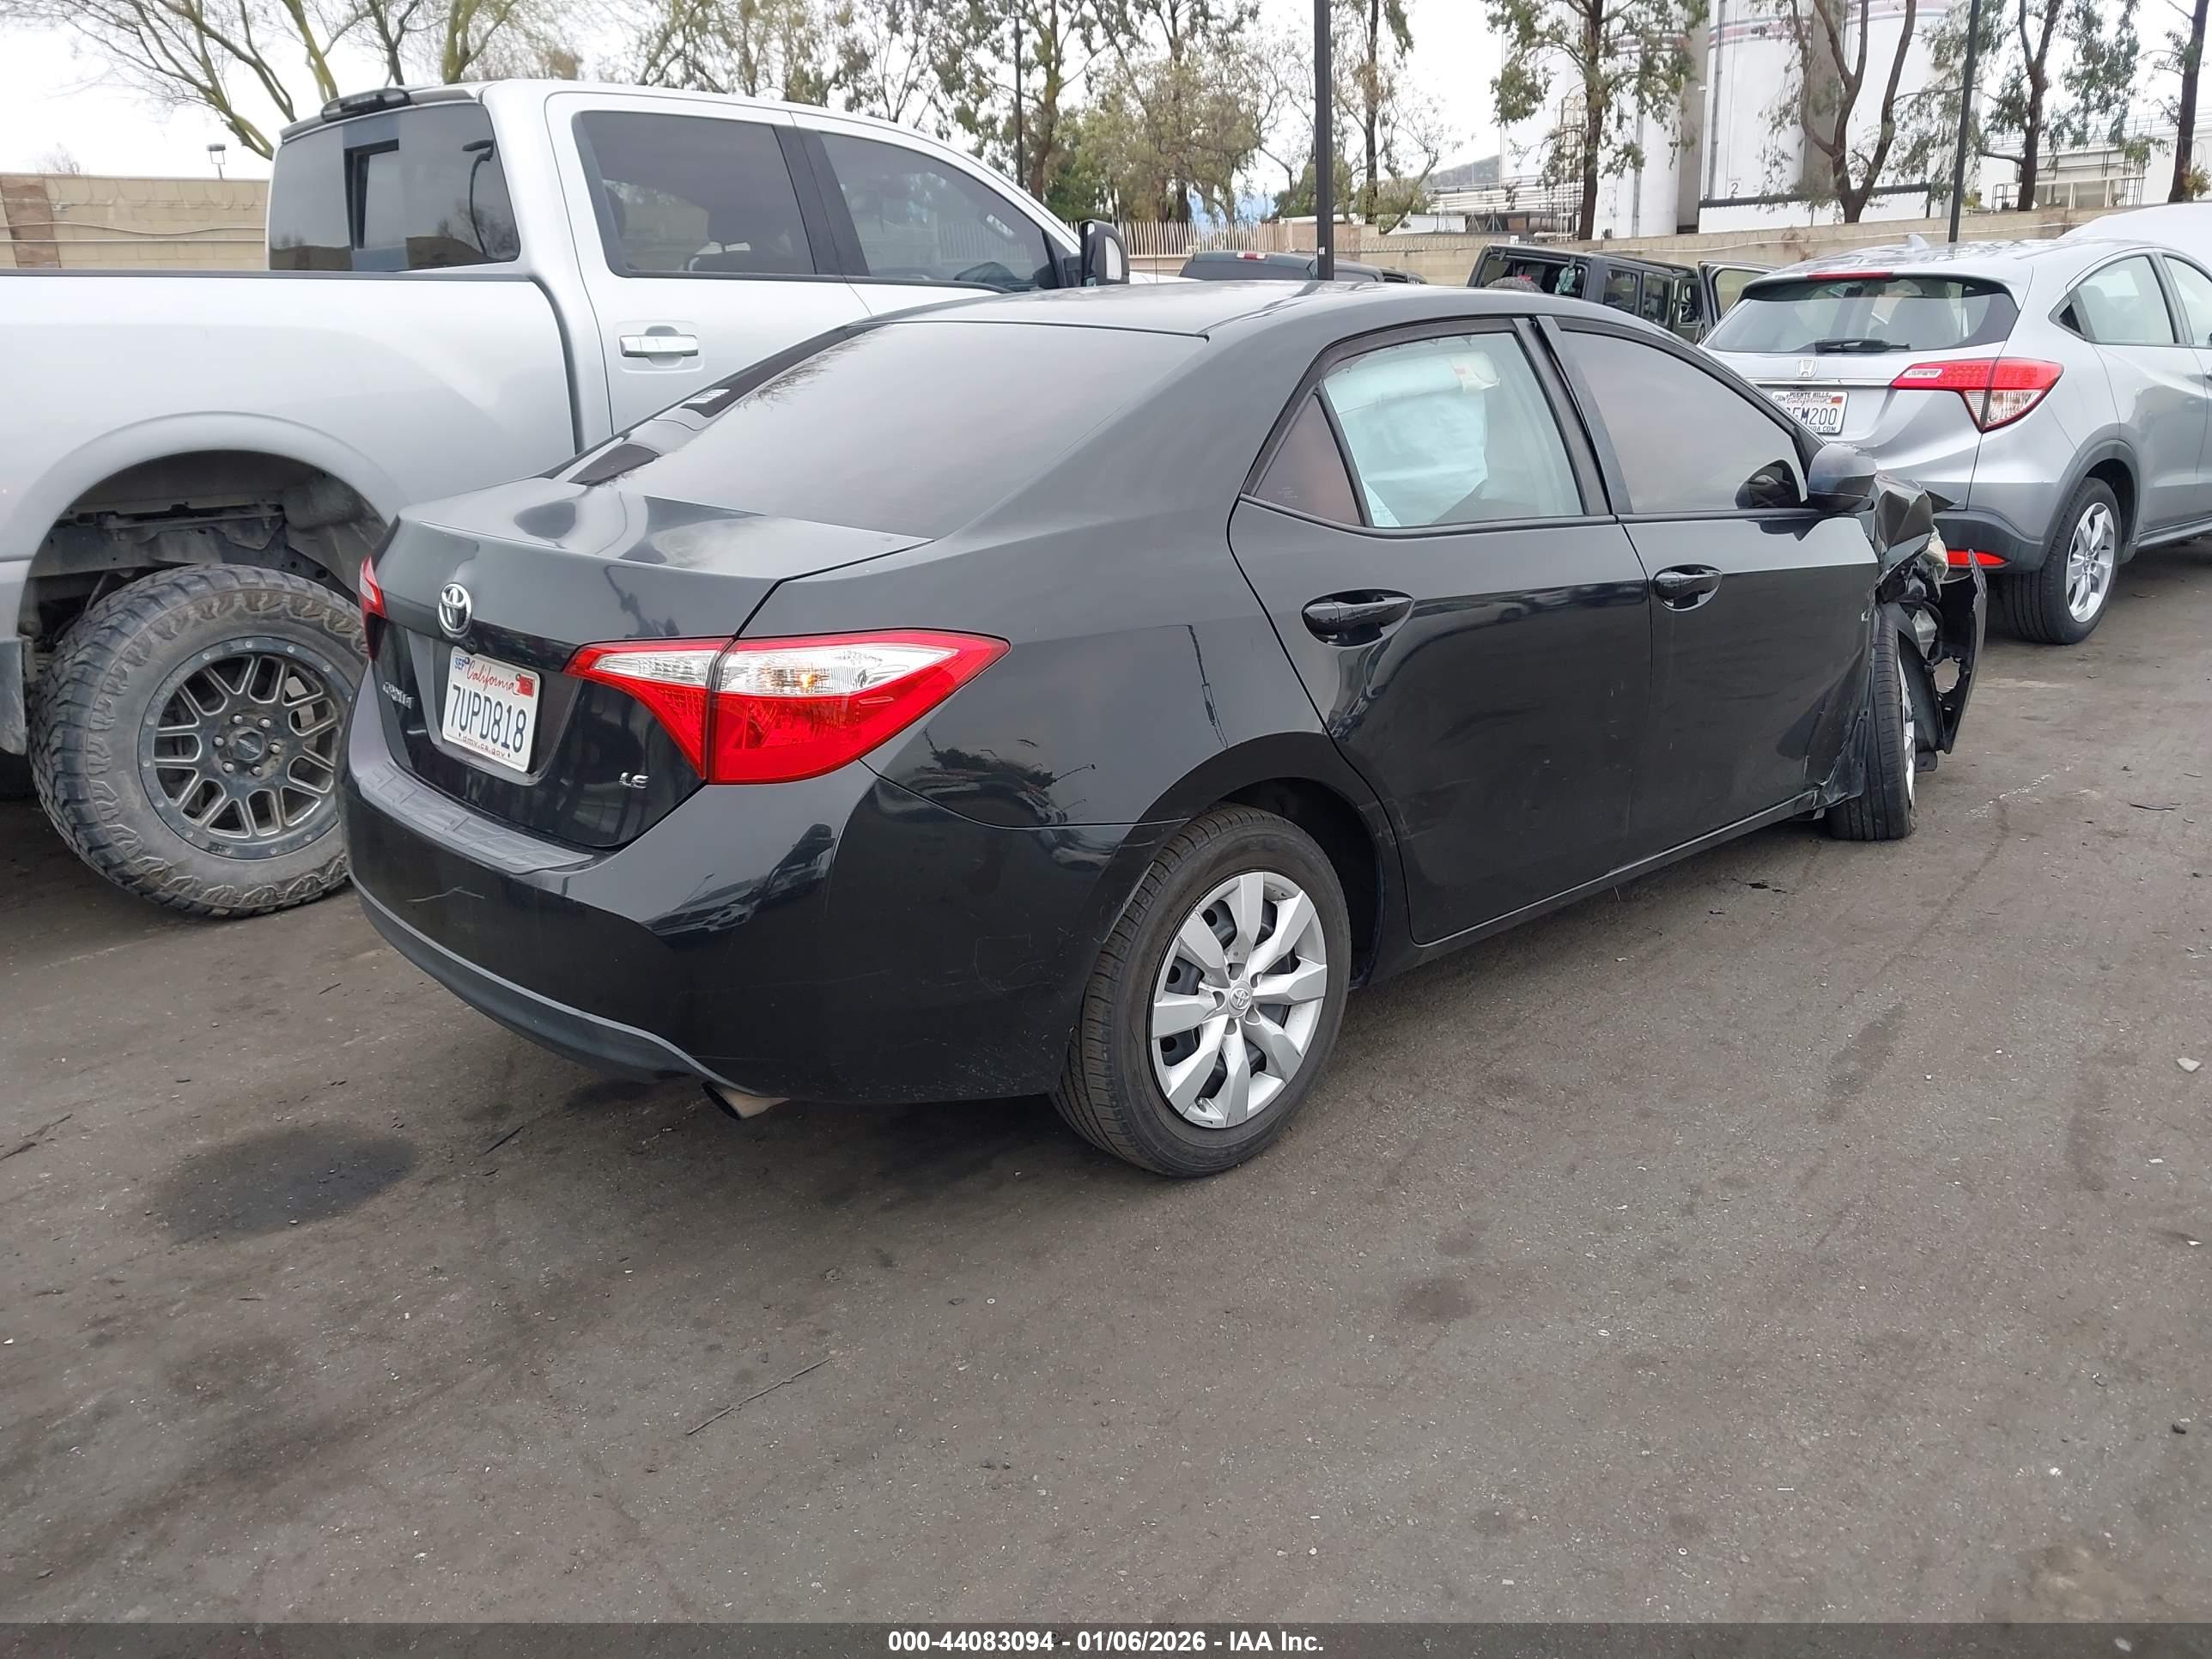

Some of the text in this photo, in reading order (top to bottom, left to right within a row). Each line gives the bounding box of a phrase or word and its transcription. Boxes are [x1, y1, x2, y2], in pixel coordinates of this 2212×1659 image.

[1730, 182, 1739, 194] 2
[465, 659, 515, 691] California
[451, 684, 527, 753] 7UPD818
[462, 736, 506, 757] dmv.ca.gov
[619, 772, 648, 789] LE
